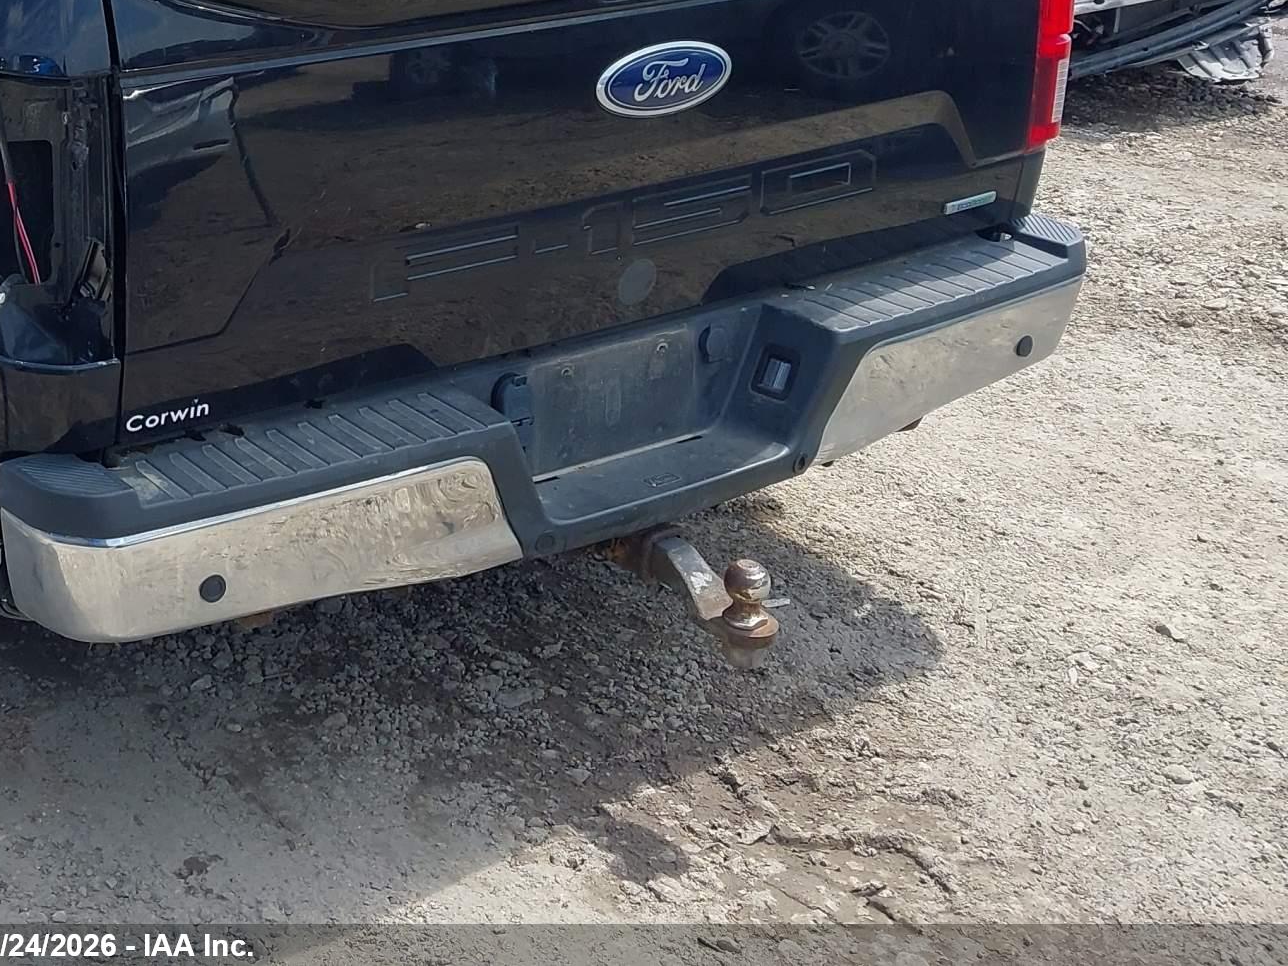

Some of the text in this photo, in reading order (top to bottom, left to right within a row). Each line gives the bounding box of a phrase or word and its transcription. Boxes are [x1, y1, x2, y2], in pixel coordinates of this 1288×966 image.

[633, 57, 708, 102] Ford
[369, 149, 877, 303] F-150
[125, 398, 210, 432] Corwin
